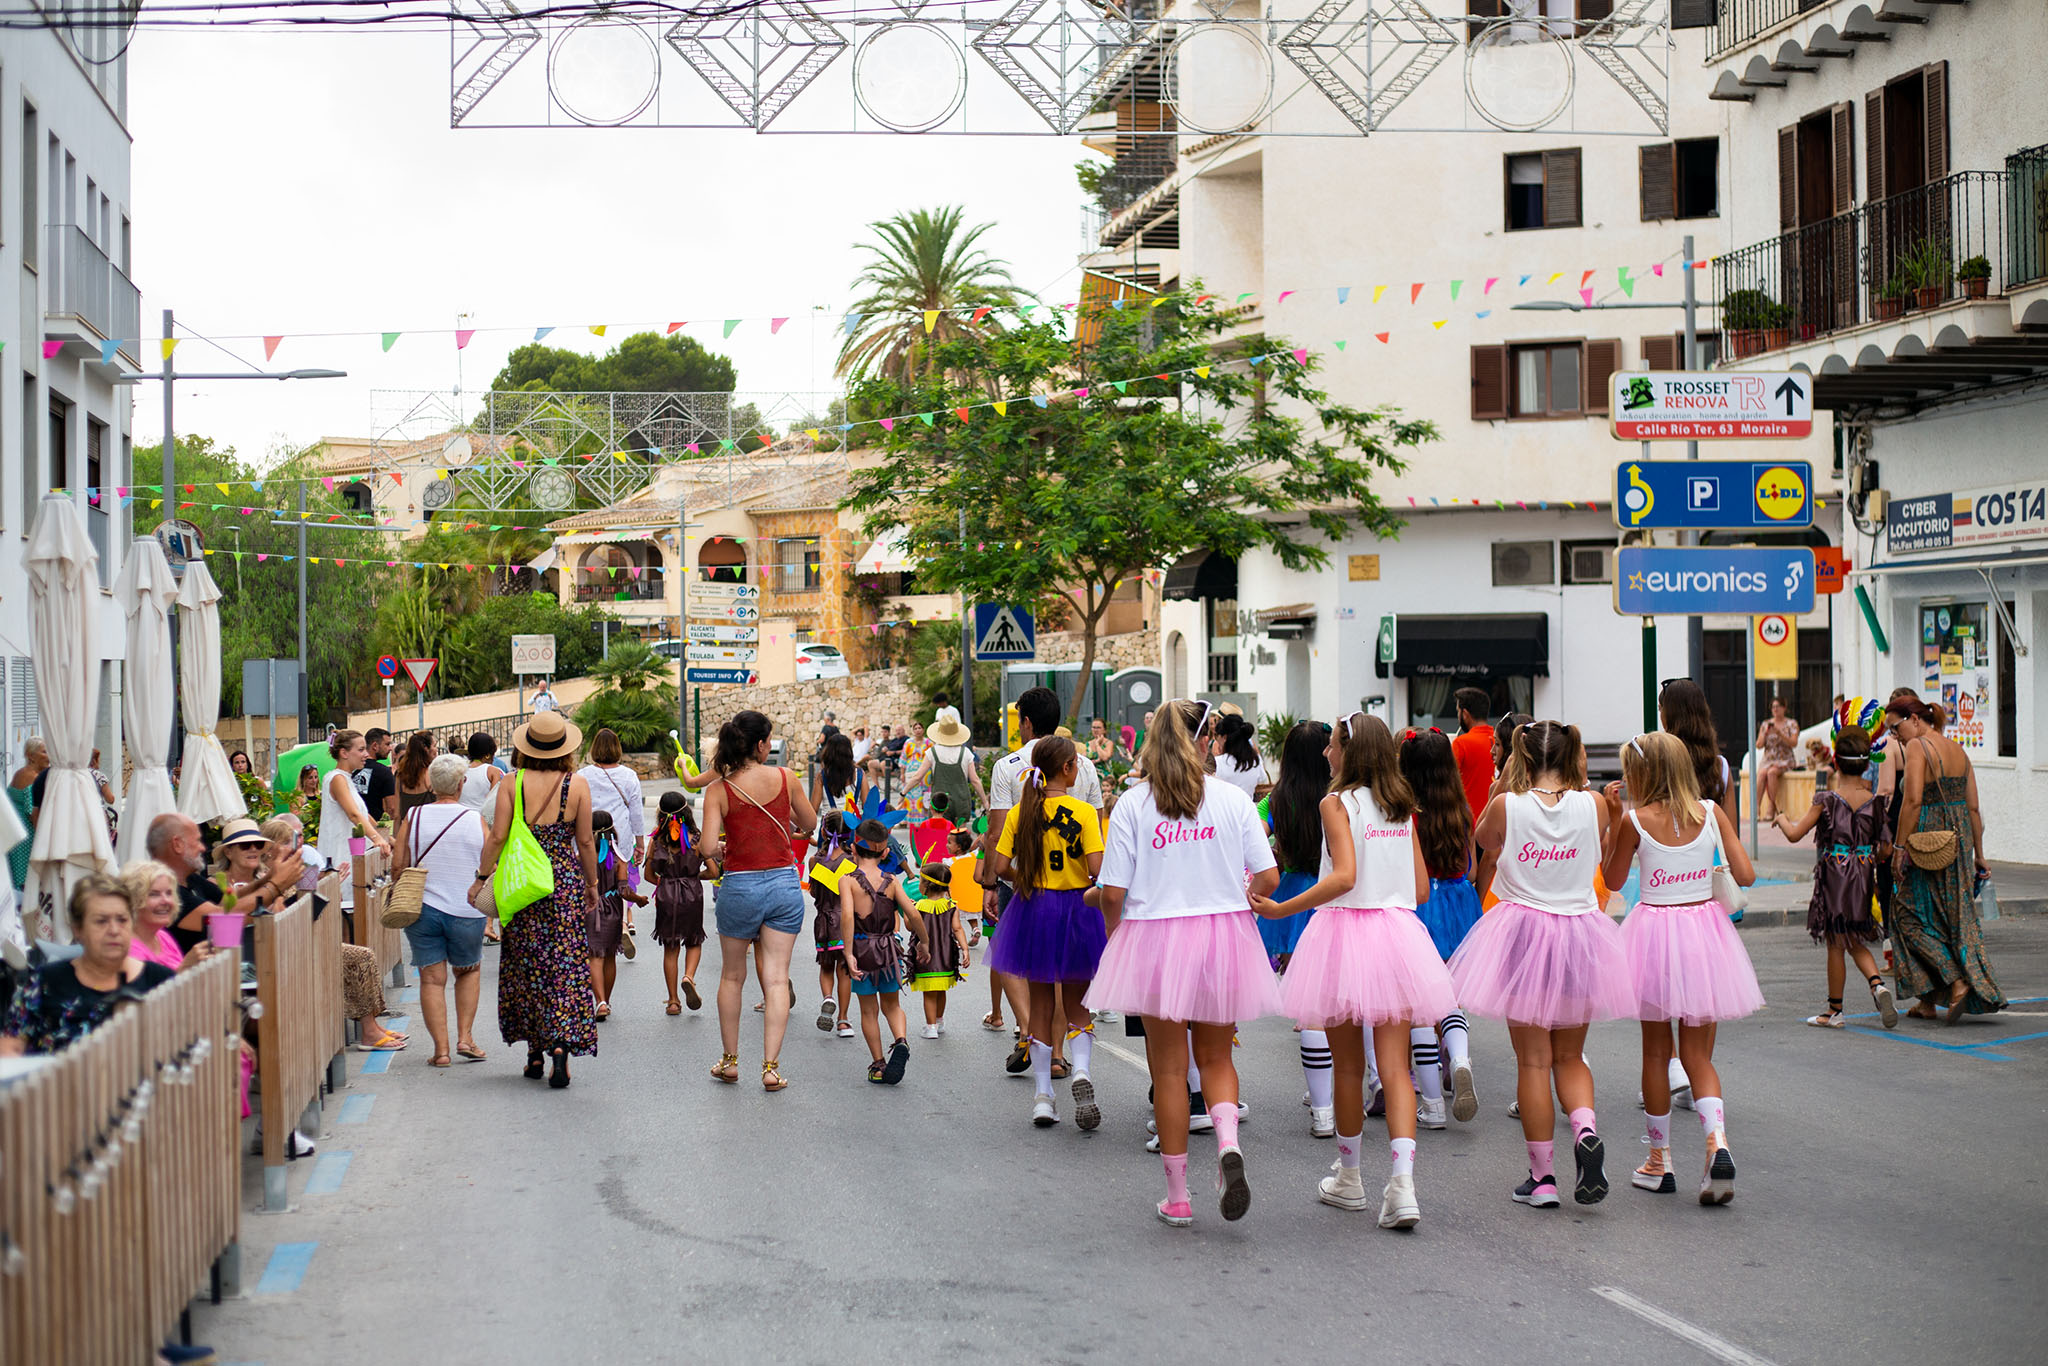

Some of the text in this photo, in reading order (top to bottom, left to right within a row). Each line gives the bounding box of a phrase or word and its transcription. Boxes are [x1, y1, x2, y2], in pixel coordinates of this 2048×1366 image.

[1664, 381, 1730, 394] TROSSET
[1665, 396, 1729, 409] RENOVA
[1649, 412, 1692, 420] decoration
[1699, 412, 1722, 420] home
[1724, 412, 1739, 420] and
[1636, 424, 1667, 435] Calle
[1719, 424, 1734, 435] 63
[1741, 424, 1788, 435] Moraira
[1902, 501, 1937, 519] CYBER
[1976, 488, 2045, 527] COSTA
[1890, 517, 1950, 538] LOCUTORIO
[1646, 566, 1767, 593] euronics
[689, 652, 715, 660] TEULADA
[1152, 820, 1216, 849] Silvia
[1518, 841, 1580, 868] Sophia
[1650, 868, 1707, 888] Sienna
